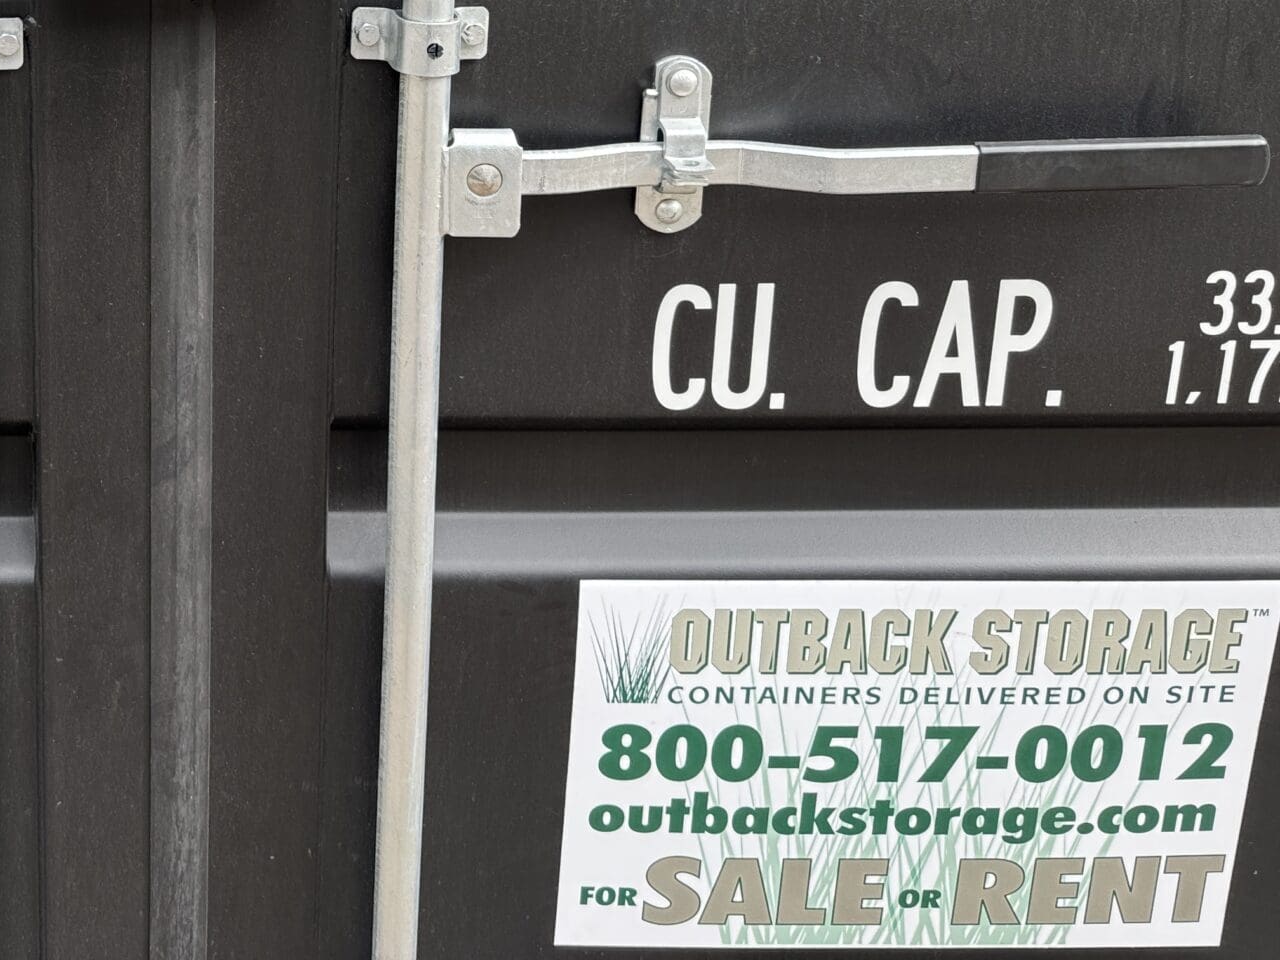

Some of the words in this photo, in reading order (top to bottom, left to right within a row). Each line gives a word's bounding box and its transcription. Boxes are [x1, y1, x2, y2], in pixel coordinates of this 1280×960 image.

[652, 282, 785, 410] CU.
[857, 278, 1063, 409] CAP.
[1165, 340, 1280, 405] 1,17
[668, 608, 957, 676] OUTBACK
[967, 608, 1249, 675] STORAGE
[667, 685, 882, 705] CONTAINERS
[899, 686, 1086, 705] DELIVERED
[1103, 685, 1149, 704] ON
[1166, 684, 1236, 704] SITE
[597, 723, 1234, 783] 800-517-0012
[588, 792, 1217, 844] outbackstorage.com
[579, 885, 637, 908] FOR
[641, 855, 890, 927] SALE
[898, 889, 941, 909] OR
[950, 854, 1226, 926] RENT
